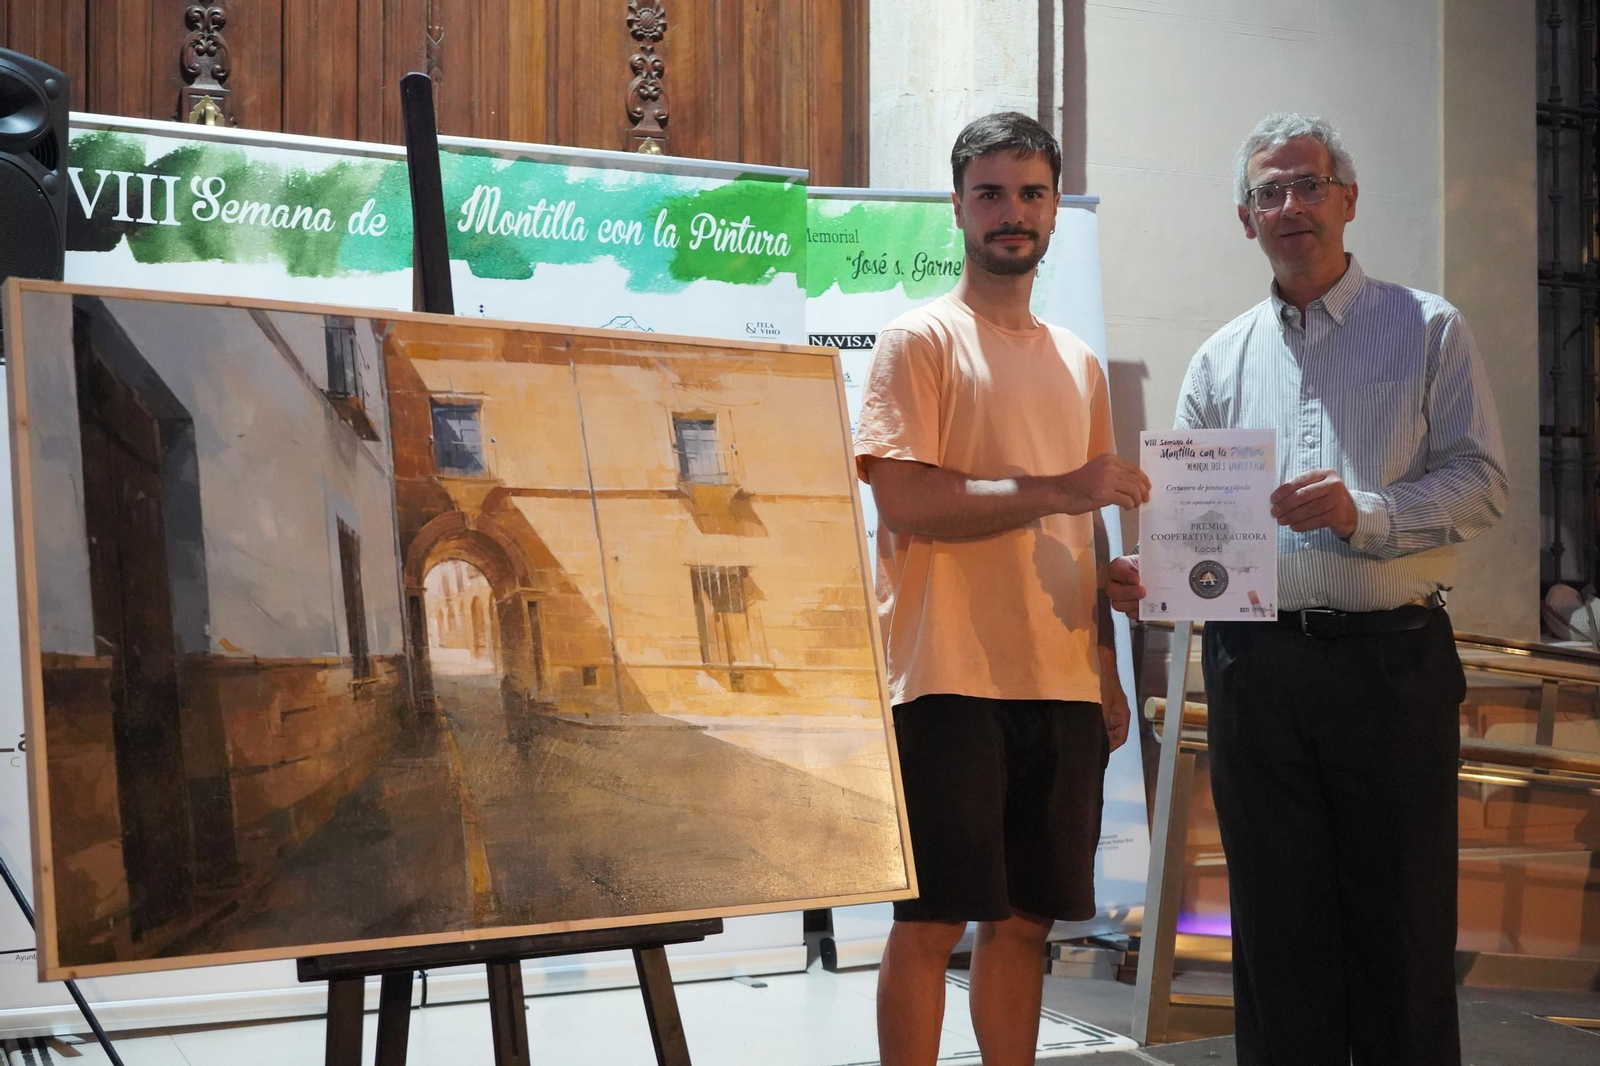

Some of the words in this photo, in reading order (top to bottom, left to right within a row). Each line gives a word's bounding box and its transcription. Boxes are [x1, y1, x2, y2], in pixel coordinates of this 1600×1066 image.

[67, 167, 181, 226] VIII
[190, 175, 336, 233] Semana
[347, 198, 389, 237] de
[457, 184, 590, 242] Montilla
[597, 218, 645, 246] con
[653, 208, 681, 248] la
[689, 212, 792, 257] Pintura
[756, 321, 775, 329] TELA
[760, 328, 781, 336] VINO
[810, 335, 874, 347] NAVISA
[1160, 439, 1184, 447] Semana
[1185, 437, 1193, 445] de
[1160, 446, 1196, 460] Montilla
[1199, 449, 1216, 460] con
[1218, 446, 1227, 457] la
